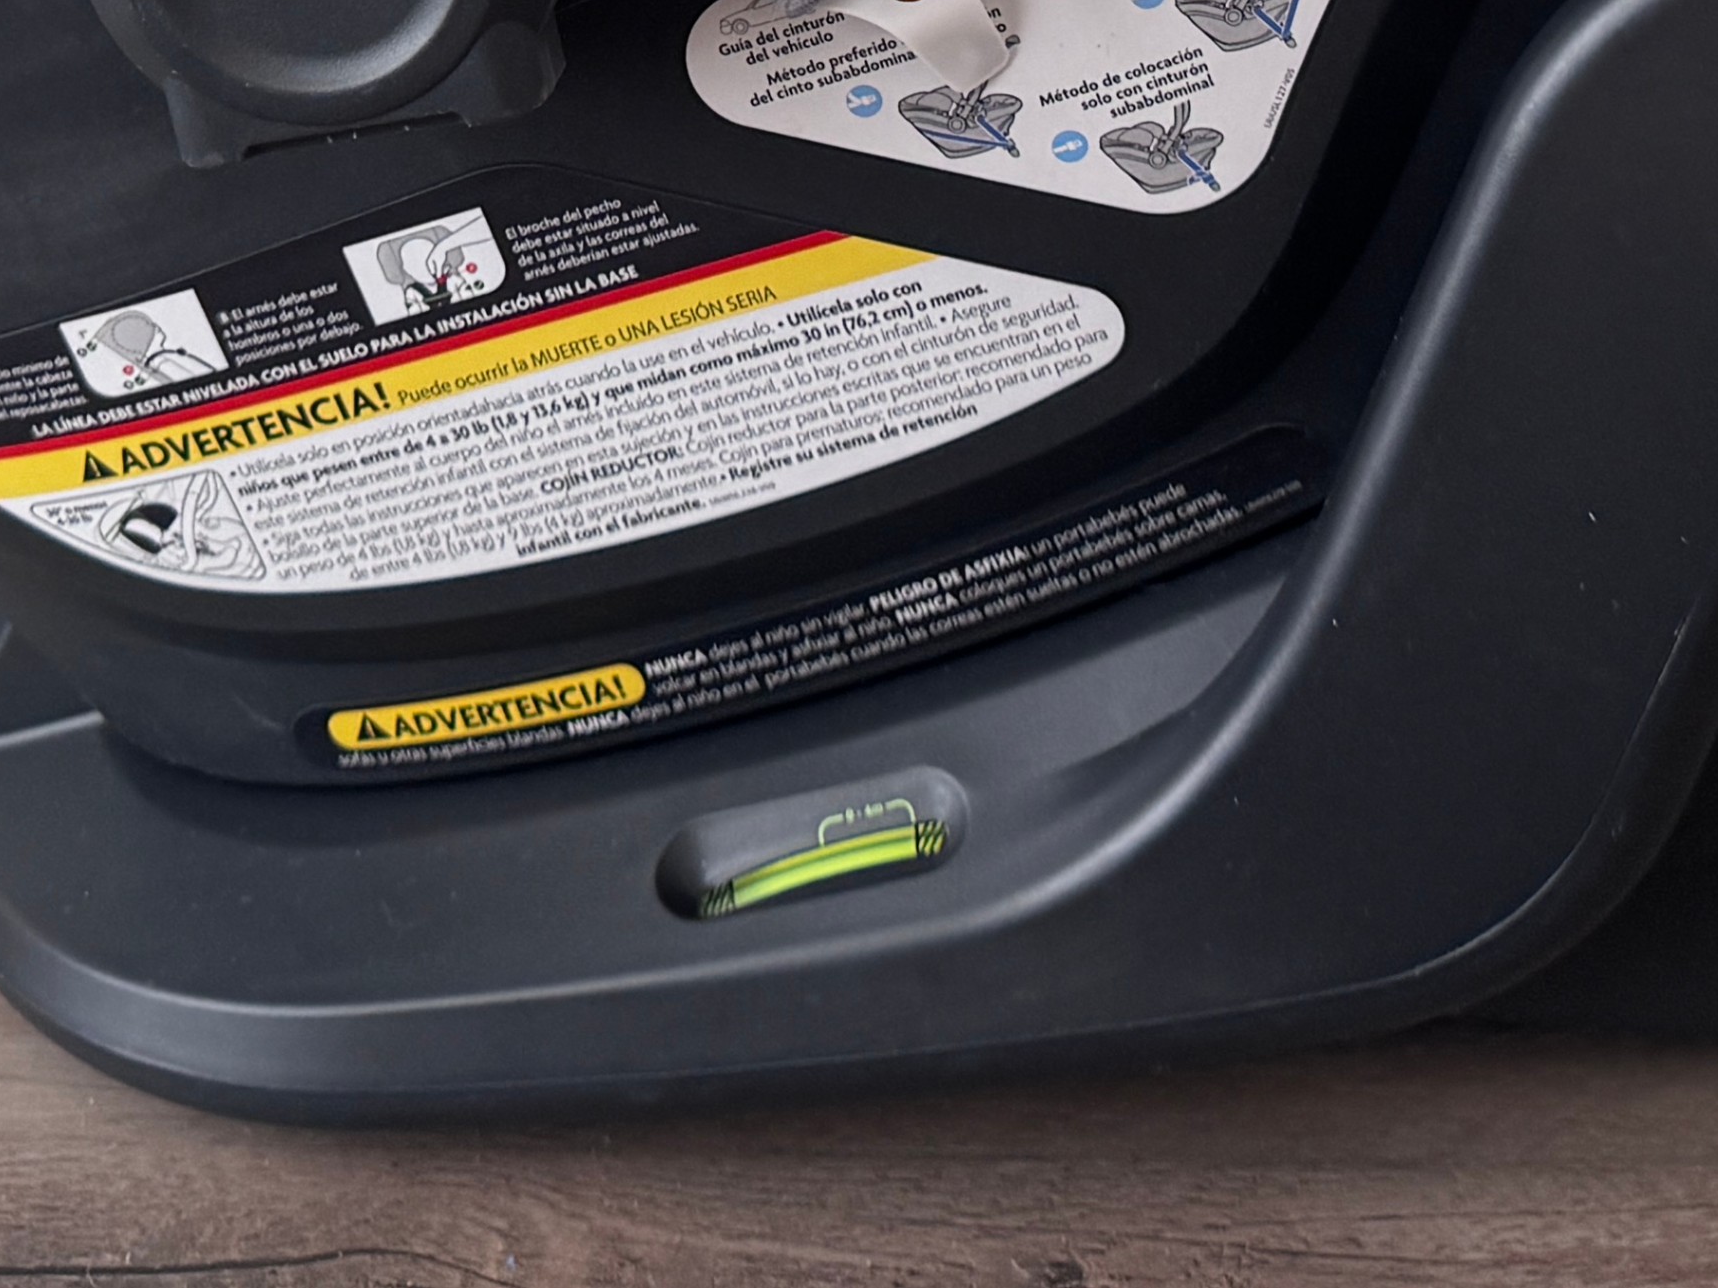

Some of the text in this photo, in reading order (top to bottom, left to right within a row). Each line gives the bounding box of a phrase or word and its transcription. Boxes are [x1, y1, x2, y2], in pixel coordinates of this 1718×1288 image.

[718, 11, 845, 56] Guía del cinturón
[746, 31, 834, 65] del vehículo
[766, 38, 897, 86] Método preferido
[750, 51, 916, 107] del cinto subabdomina
[1039, 48, 1203, 107] Método de colocación
[1081, 63, 1209, 111] solo con cinturón
[1110, 73, 1215, 118] subabdominal
[505, 200, 621, 240] El broche del pecho
[512, 200, 660, 253] debe estar situado a nivel
[518, 213, 669, 267] de la axila y las correas del
[524, 223, 699, 281] arnés deberían estar ajustadas.
[32, 264, 639, 438] LA LÍNEA DEBE ESTAR NIVELADA CON EL SUELO PARA LA INSTALACIÓN SIN LA BASE
[121, 285, 777, 475] ADVERTENCIA! Puede ocurrir la MUERTE o UNA LESIÓN SERIA
[238, 454, 295, 477] Utilícela
[298, 445, 329, 463] solo
[331, 442, 351, 453] en
[353, 424, 415, 451] posición
[528, 382, 563, 400] atrás
[565, 364, 621, 389] cuando
[621, 359, 637, 373] la
[639, 354, 665, 369] use
[668, 348, 689, 360] en
[691, 338, 705, 354] el
[707, 323, 775, 349] vehículo.
[786, 300, 853, 327] Utilícela
[855, 290, 890, 309] solo
[892, 281, 922, 298] con
[281, 472, 309, 489] que
[312, 459, 357, 482] pesen
[360, 448, 400, 466] entre
[403, 439, 423, 454] de
[426, 435, 436, 447] 4
[440, 435, 449, 445] a
[451, 425, 470, 442] 30
[471, 420, 489, 435] lb
[491, 412, 518, 433] (1,8
[520, 411, 529, 425] y
[532, 399, 561, 418] 13,6
[562, 391, 590, 410] kg)
[591, 391, 600, 405] y
[604, 383, 634, 400] que
[637, 368, 687, 390] midan
[689, 355, 733, 375] como
[736, 336, 800, 362] máximo
[801, 327, 822, 344] 30
[823, 323, 841, 338] in
[842, 311, 880, 335] (76,2
[883, 301, 914, 321] cm)
[916, 301, 927, 311] o
[930, 284, 988, 308] menos.
[728, 404, 978, 481] Registre su sistema de retención
[516, 499, 706, 557] infantil con el fabricante.
[645, 649, 707, 677] NUNCA
[869, 577, 938, 612] PELIGRO
[395, 675, 626, 738] ADVERTENCIA!
